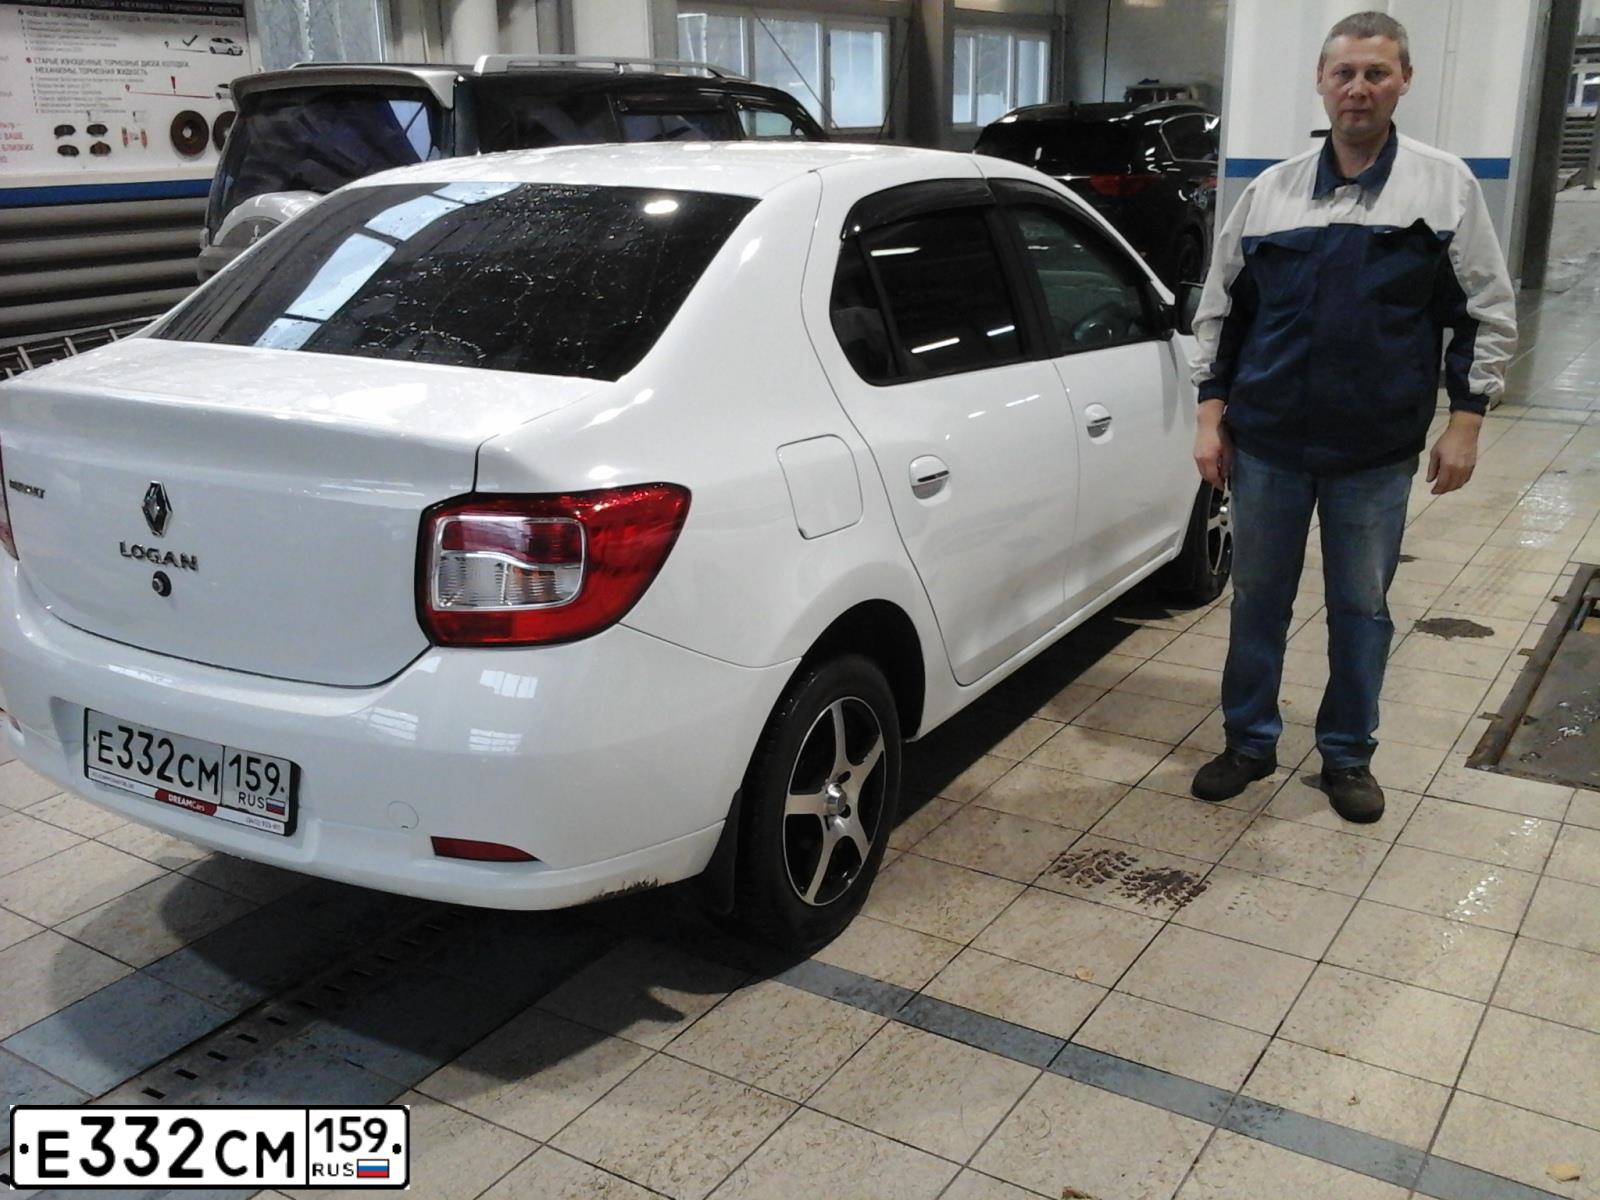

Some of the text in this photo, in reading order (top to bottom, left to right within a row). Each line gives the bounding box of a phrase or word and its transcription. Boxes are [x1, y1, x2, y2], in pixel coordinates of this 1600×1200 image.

[119, 540, 199, 571] LOGAN
[228, 753, 281, 796] 159
[238, 791, 266, 809] RUS
